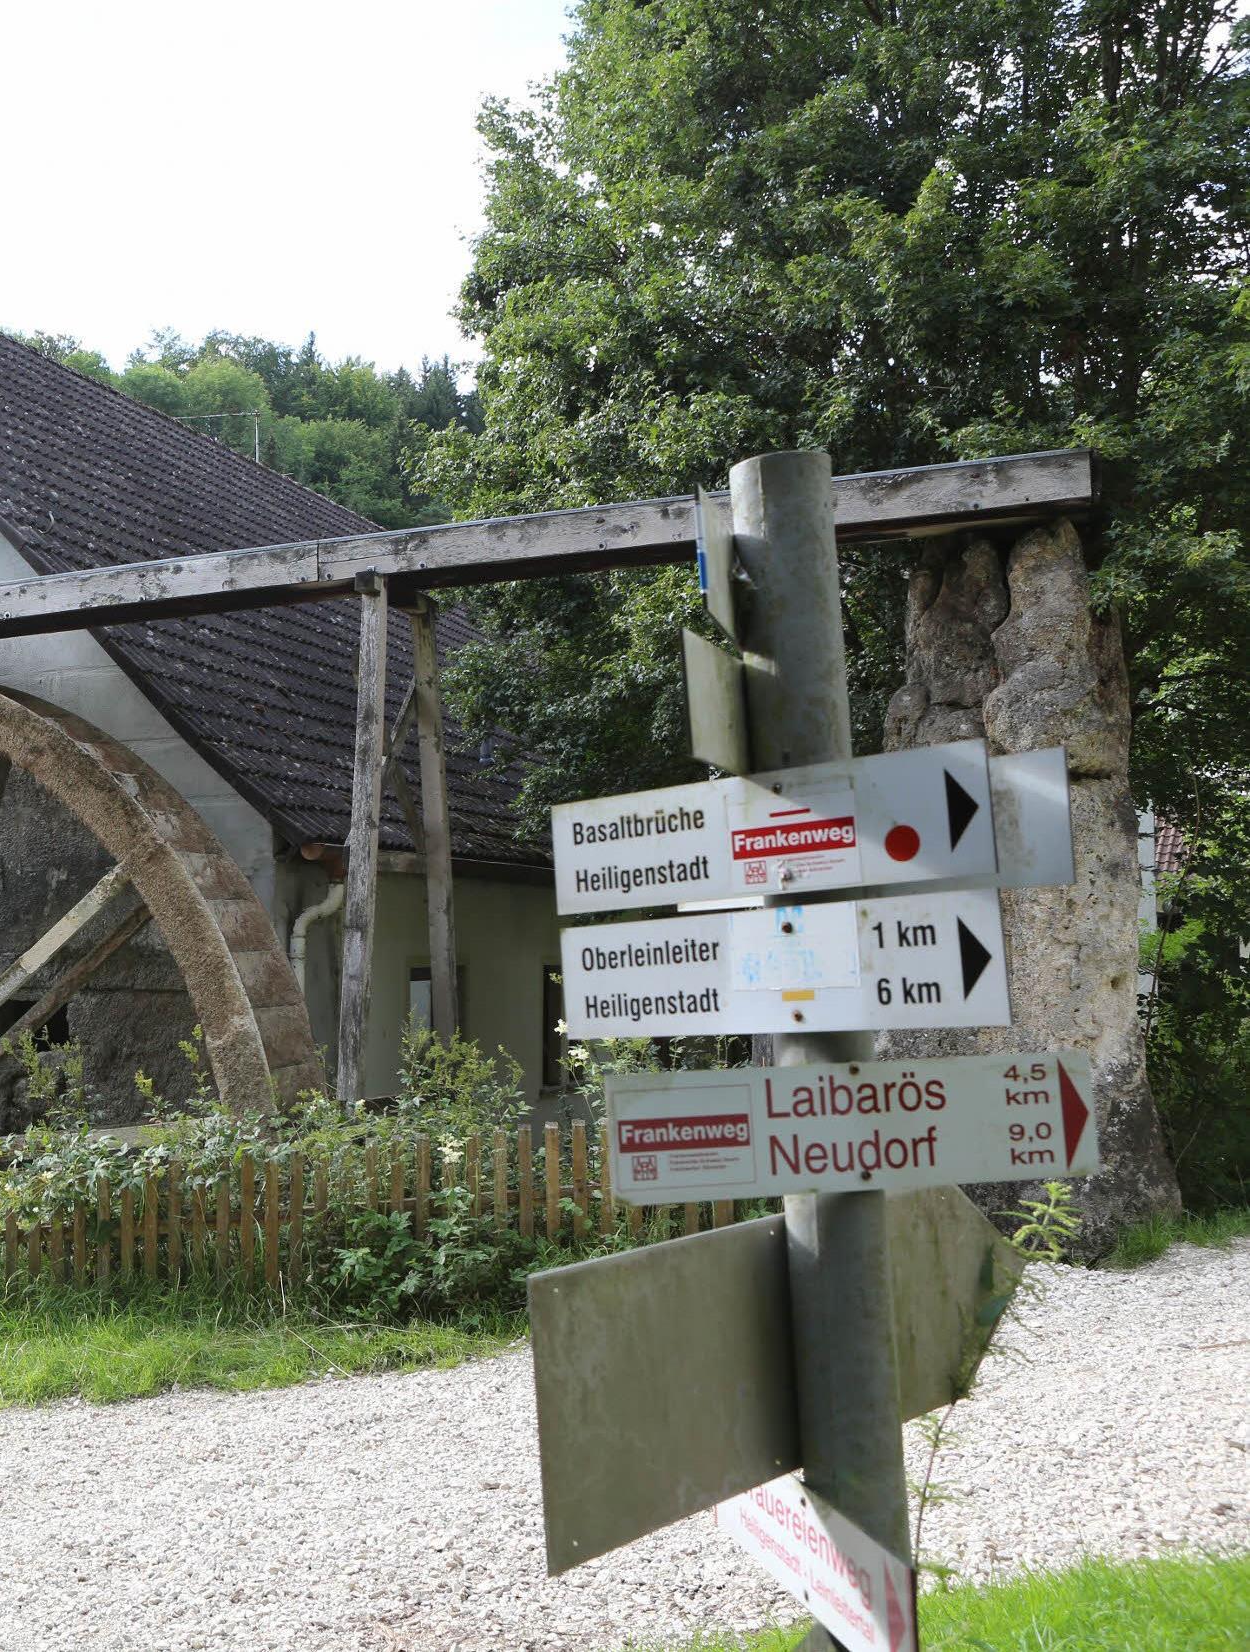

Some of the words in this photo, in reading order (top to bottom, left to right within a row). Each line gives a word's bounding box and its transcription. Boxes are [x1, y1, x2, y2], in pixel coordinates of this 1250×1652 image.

[572, 807, 705, 846] Basaltbrüche
[733, 824, 854, 853] Frankenweg
[575, 855, 710, 893] Heiligenstadt
[581, 938, 720, 971] Oberleinleiter
[872, 922, 884, 948] 1
[897, 921, 937, 947] km
[585, 988, 721, 1021] Heiligenstadt
[877, 978, 892, 1005] 6
[902, 977, 942, 1004] km
[765, 1071, 947, 1119] Laibarös
[1003, 1063, 1047, 1084] 4,5
[1005, 1088, 1050, 1106] km
[620, 1122, 748, 1145] Frankenweg
[768, 1125, 937, 1176] Neudorf
[1009, 1122, 1052, 1143] 9,0
[1010, 1147, 1055, 1165] km
